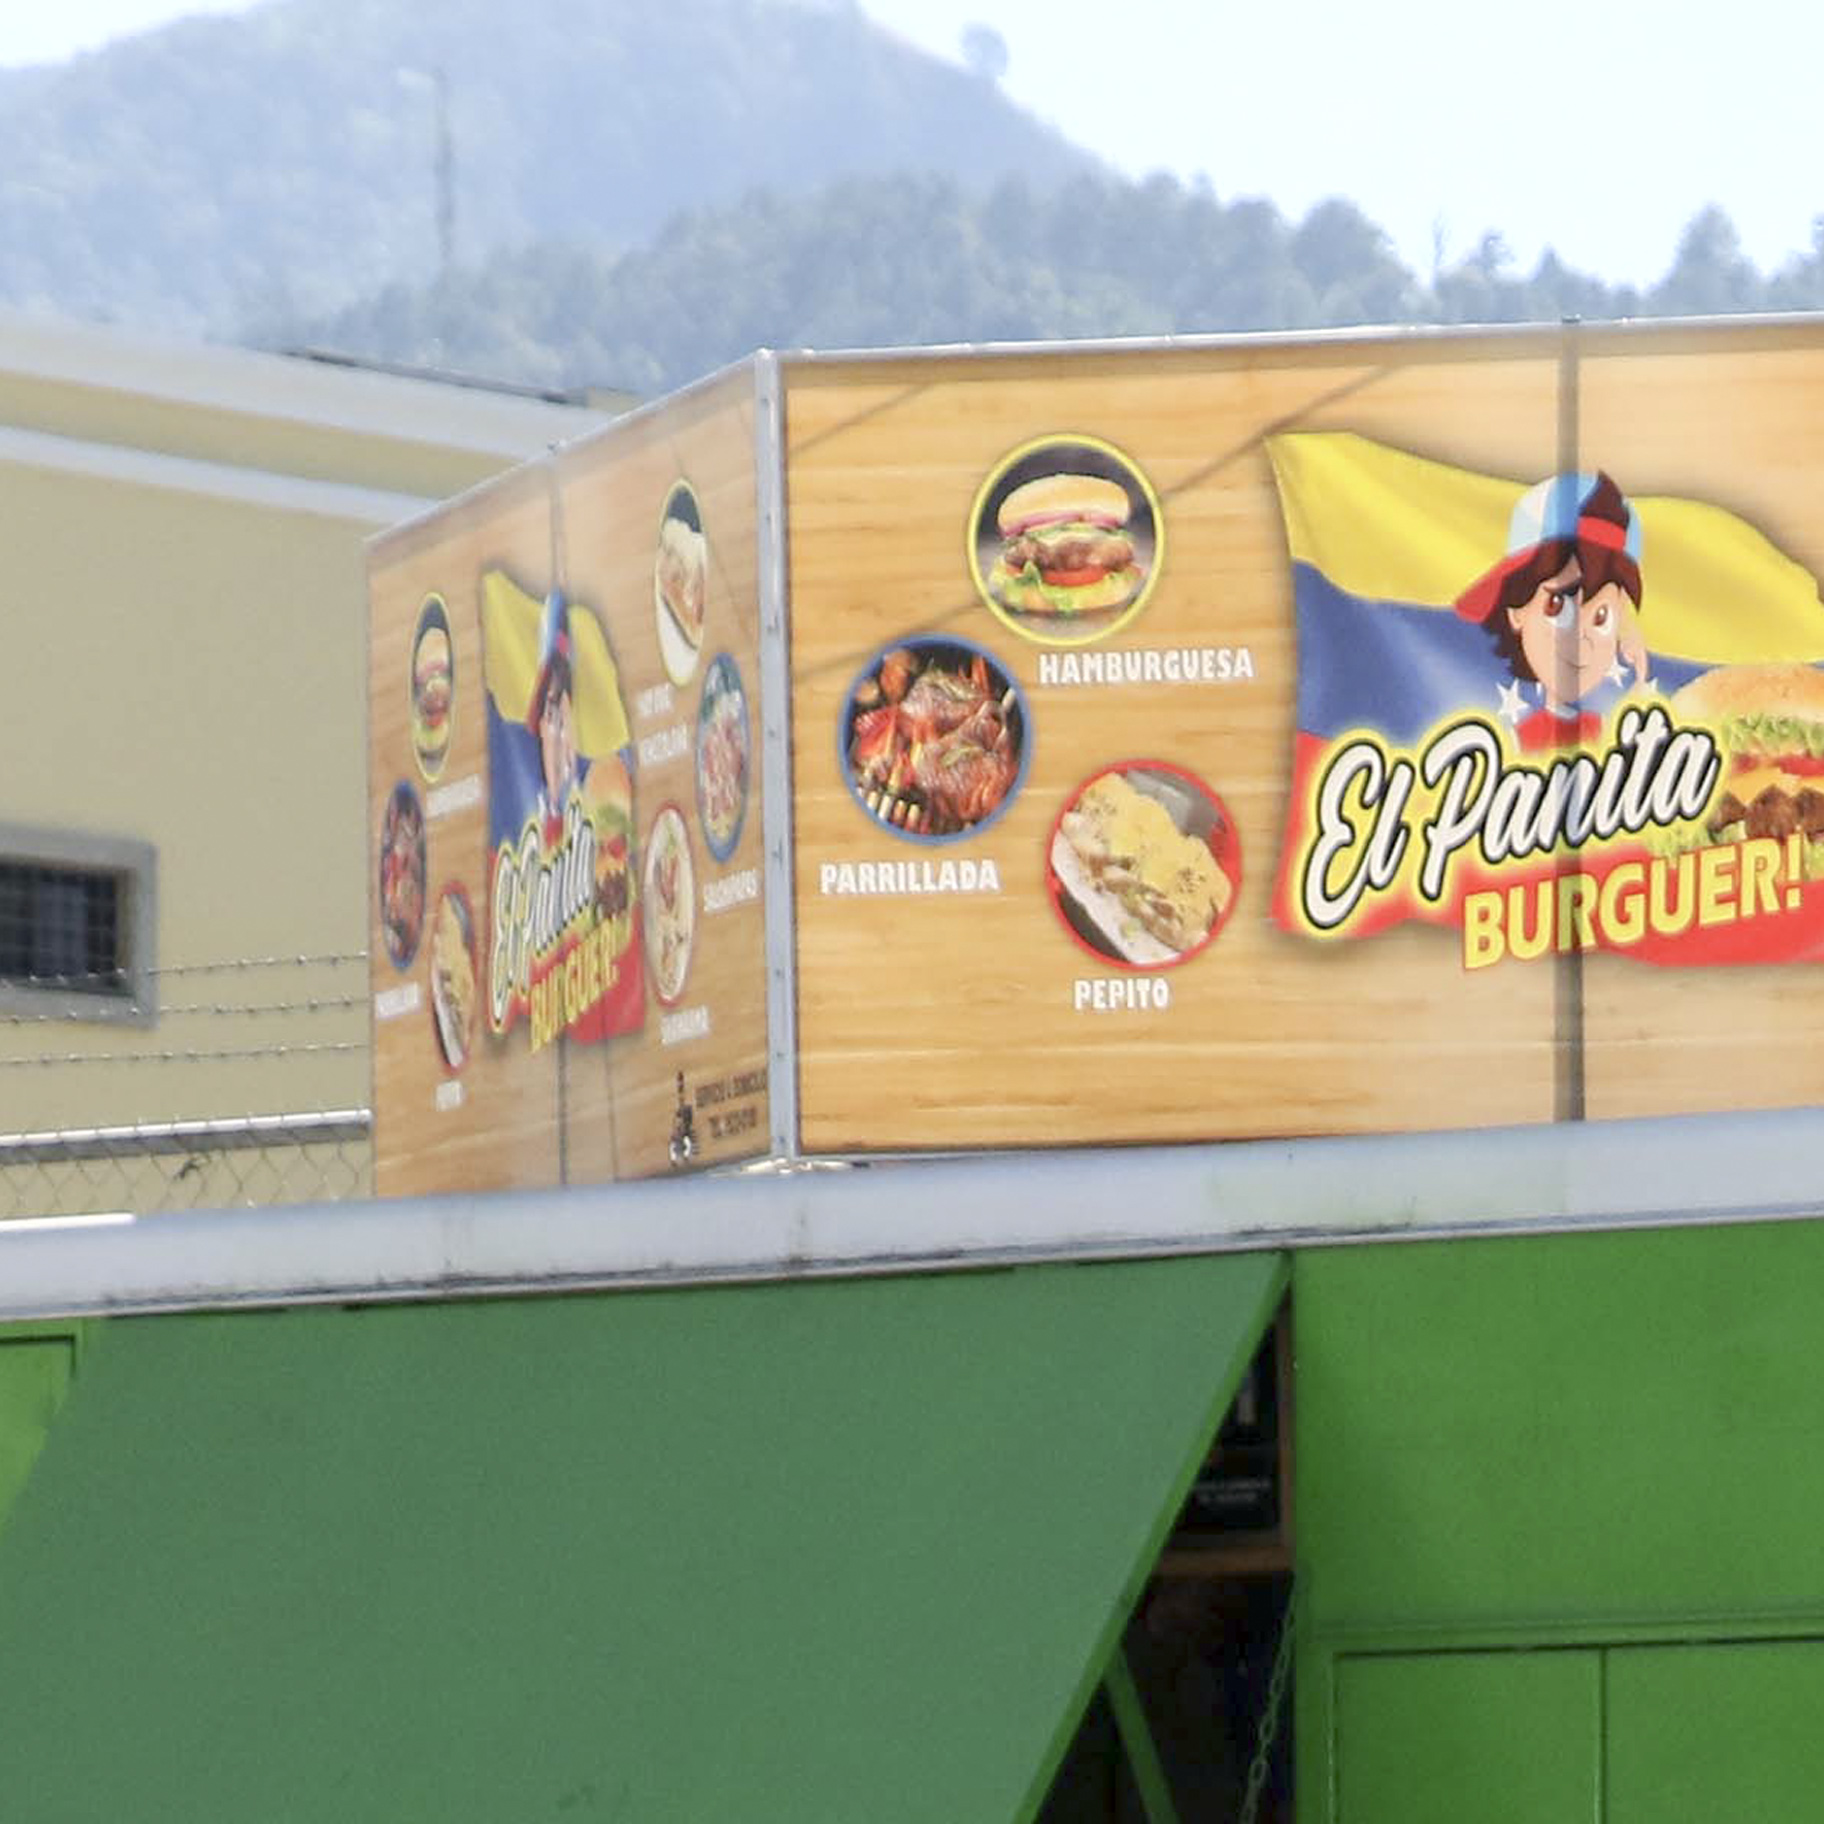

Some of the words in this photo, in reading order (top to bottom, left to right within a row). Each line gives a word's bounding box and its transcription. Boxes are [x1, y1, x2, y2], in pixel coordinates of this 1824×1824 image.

[1039, 648, 1254, 684] HAMBURGUESA
[1300, 744, 1413, 926] El
[1422, 706, 1720, 899] Panita
[820, 859, 1000, 894] PARRILLADA
[1463, 834, 1804, 969] BURGUER!
[1074, 978, 1169, 1010] PEPITO
